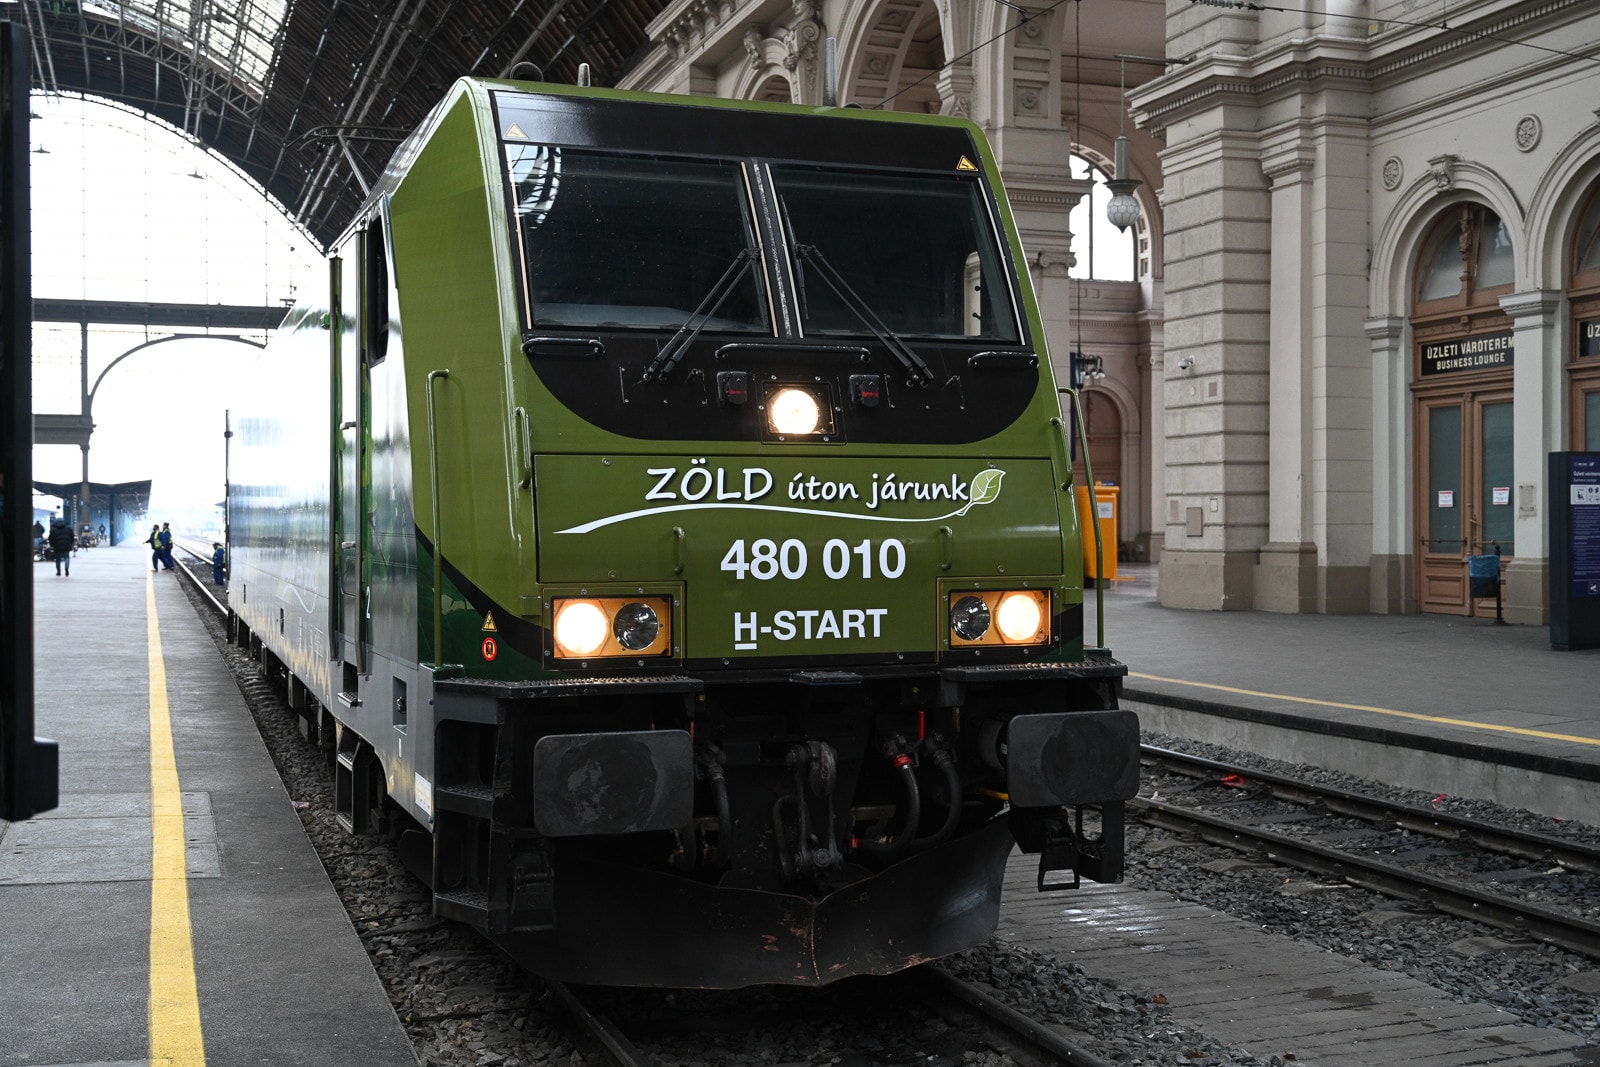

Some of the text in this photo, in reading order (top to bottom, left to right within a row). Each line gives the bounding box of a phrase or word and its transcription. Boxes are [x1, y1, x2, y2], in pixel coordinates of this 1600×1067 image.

[1427, 336, 1514, 359] ÜZLETI VÁRÓTEREM
[1436, 352, 1505, 370] BUSINESS LOUNGE
[645, 458, 969, 509] ZÖLD úton járunk
[720, 538, 906, 580] 480 010
[734, 608, 888, 650] H-START
